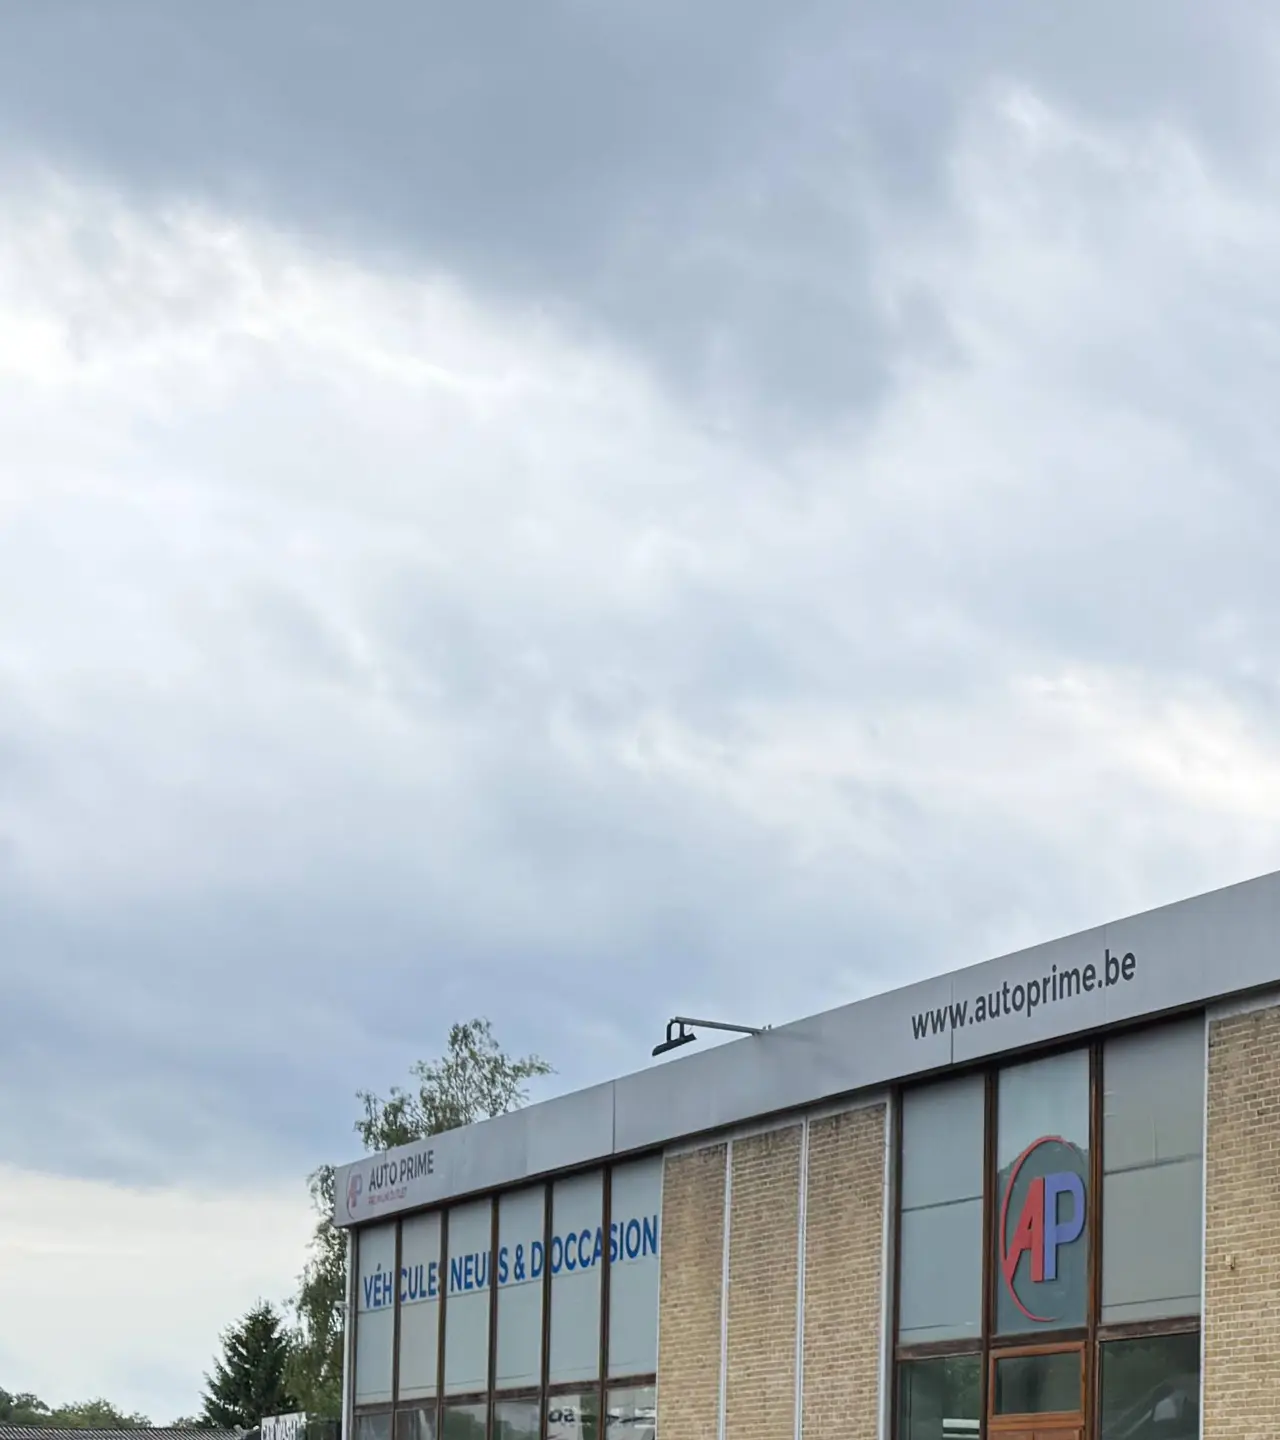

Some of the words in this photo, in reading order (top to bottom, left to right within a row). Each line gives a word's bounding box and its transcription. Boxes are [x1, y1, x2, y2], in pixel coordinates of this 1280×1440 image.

[911, 949, 1137, 1040] www.autoprime.be
[368, 1162, 398, 1193] AUTO
[399, 1149, 434, 1182] PRIME
[513, 1243, 526, 1282] &
[530, 1214, 658, 1279] DOCCASION
[1003, 1170, 1087, 1284] AP
